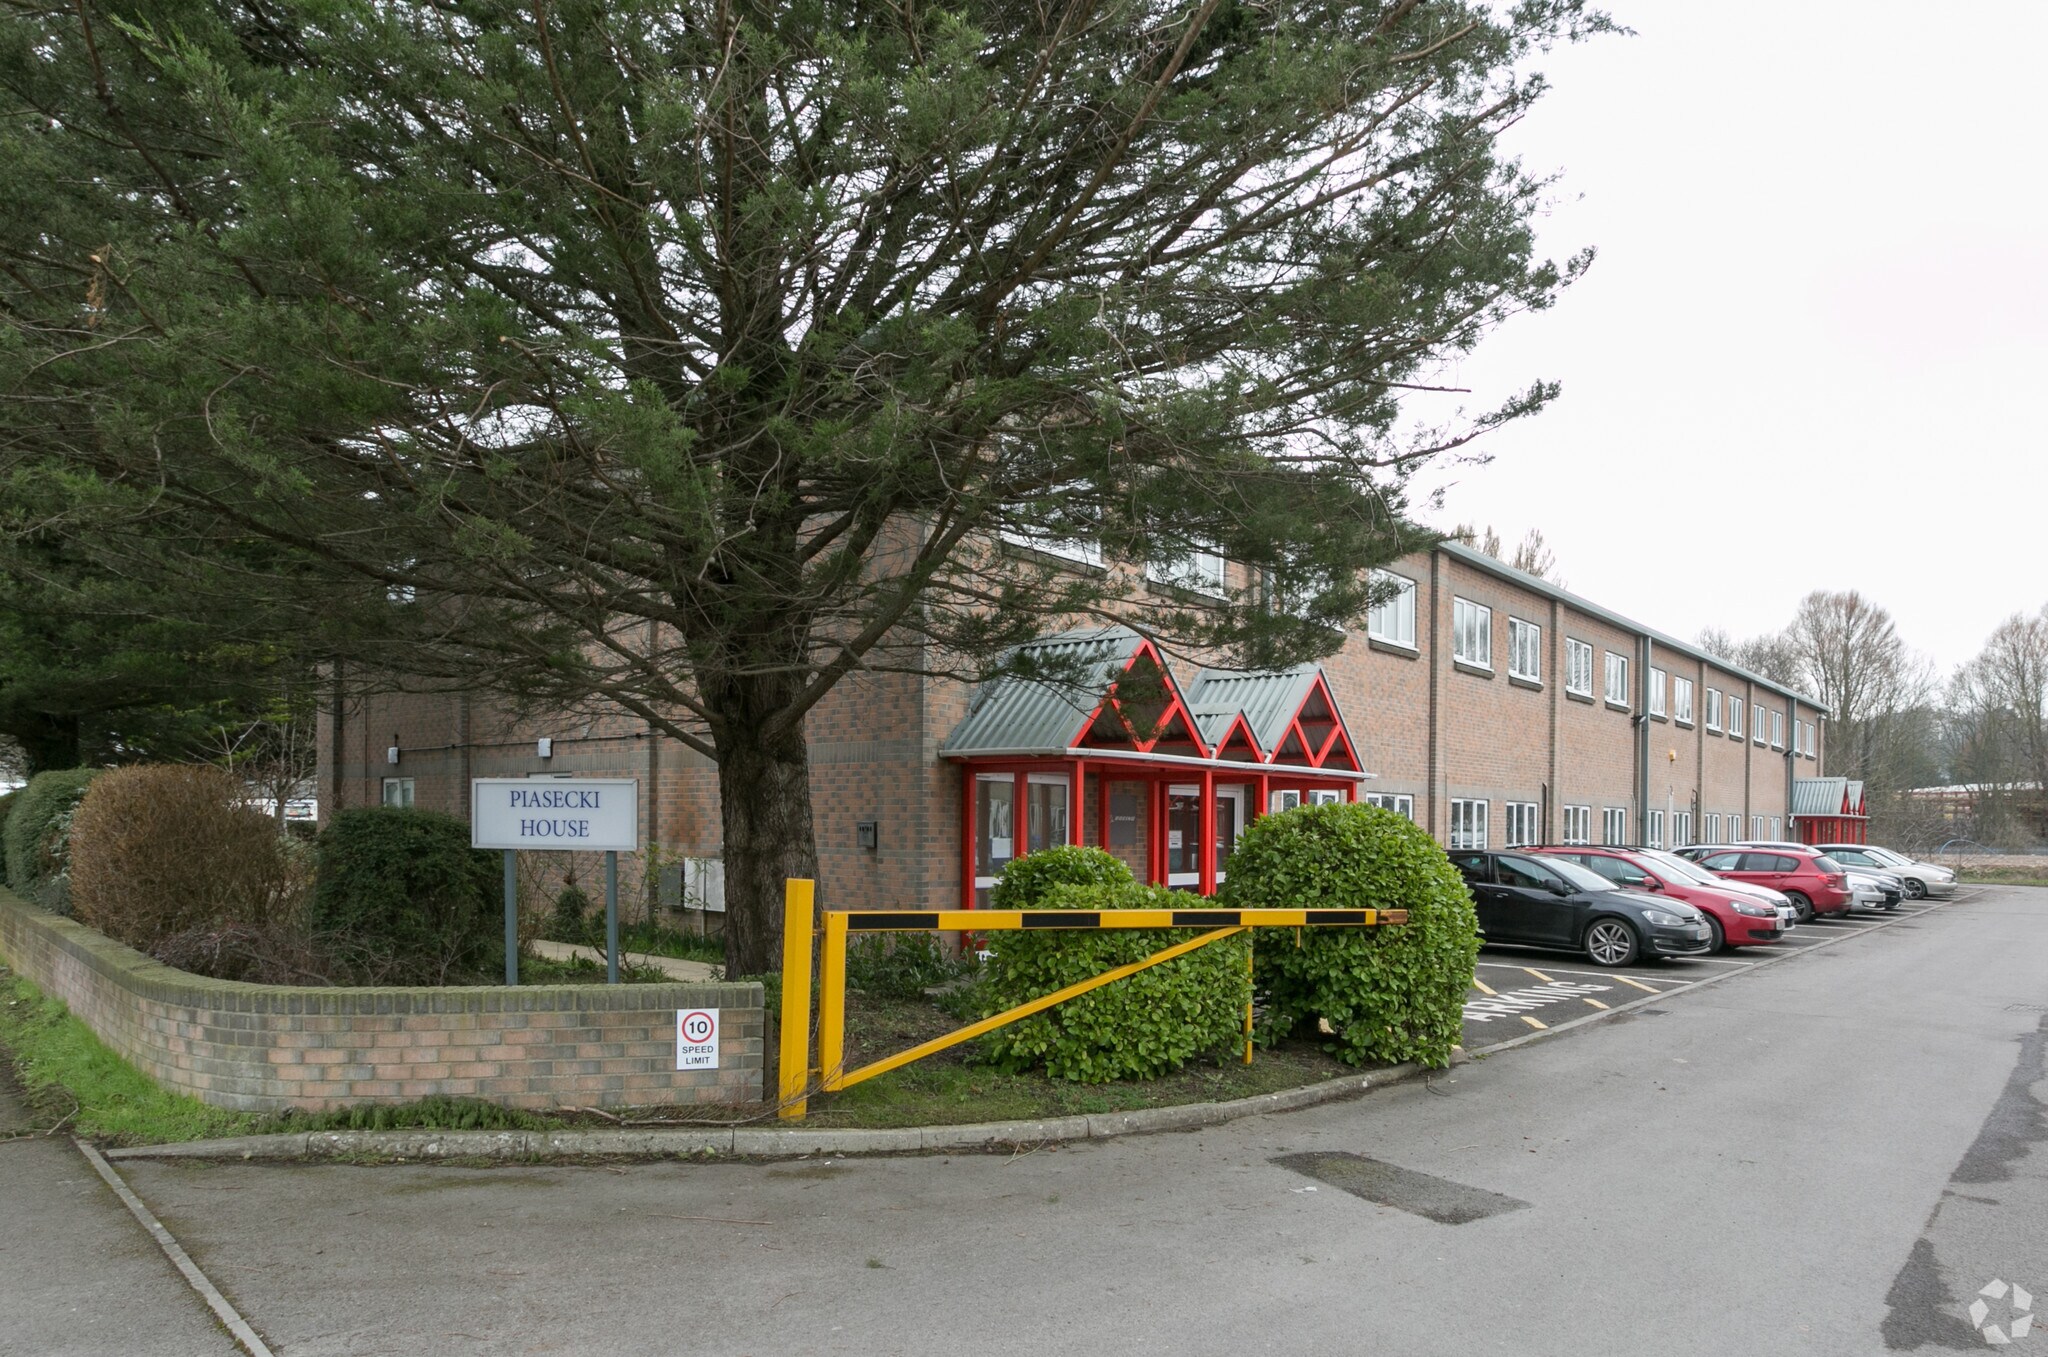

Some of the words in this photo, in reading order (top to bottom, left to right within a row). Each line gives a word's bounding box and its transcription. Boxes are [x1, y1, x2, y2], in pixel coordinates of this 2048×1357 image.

[509, 790, 600, 808] PIASECKI
[520, 819, 590, 837] HOUSE
[1462, 981, 1614, 1022] ARKING
[689, 1020, 708, 1034] 10
[682, 1045, 714, 1054] SPEED
[685, 1056, 710, 1065] LIMIT
